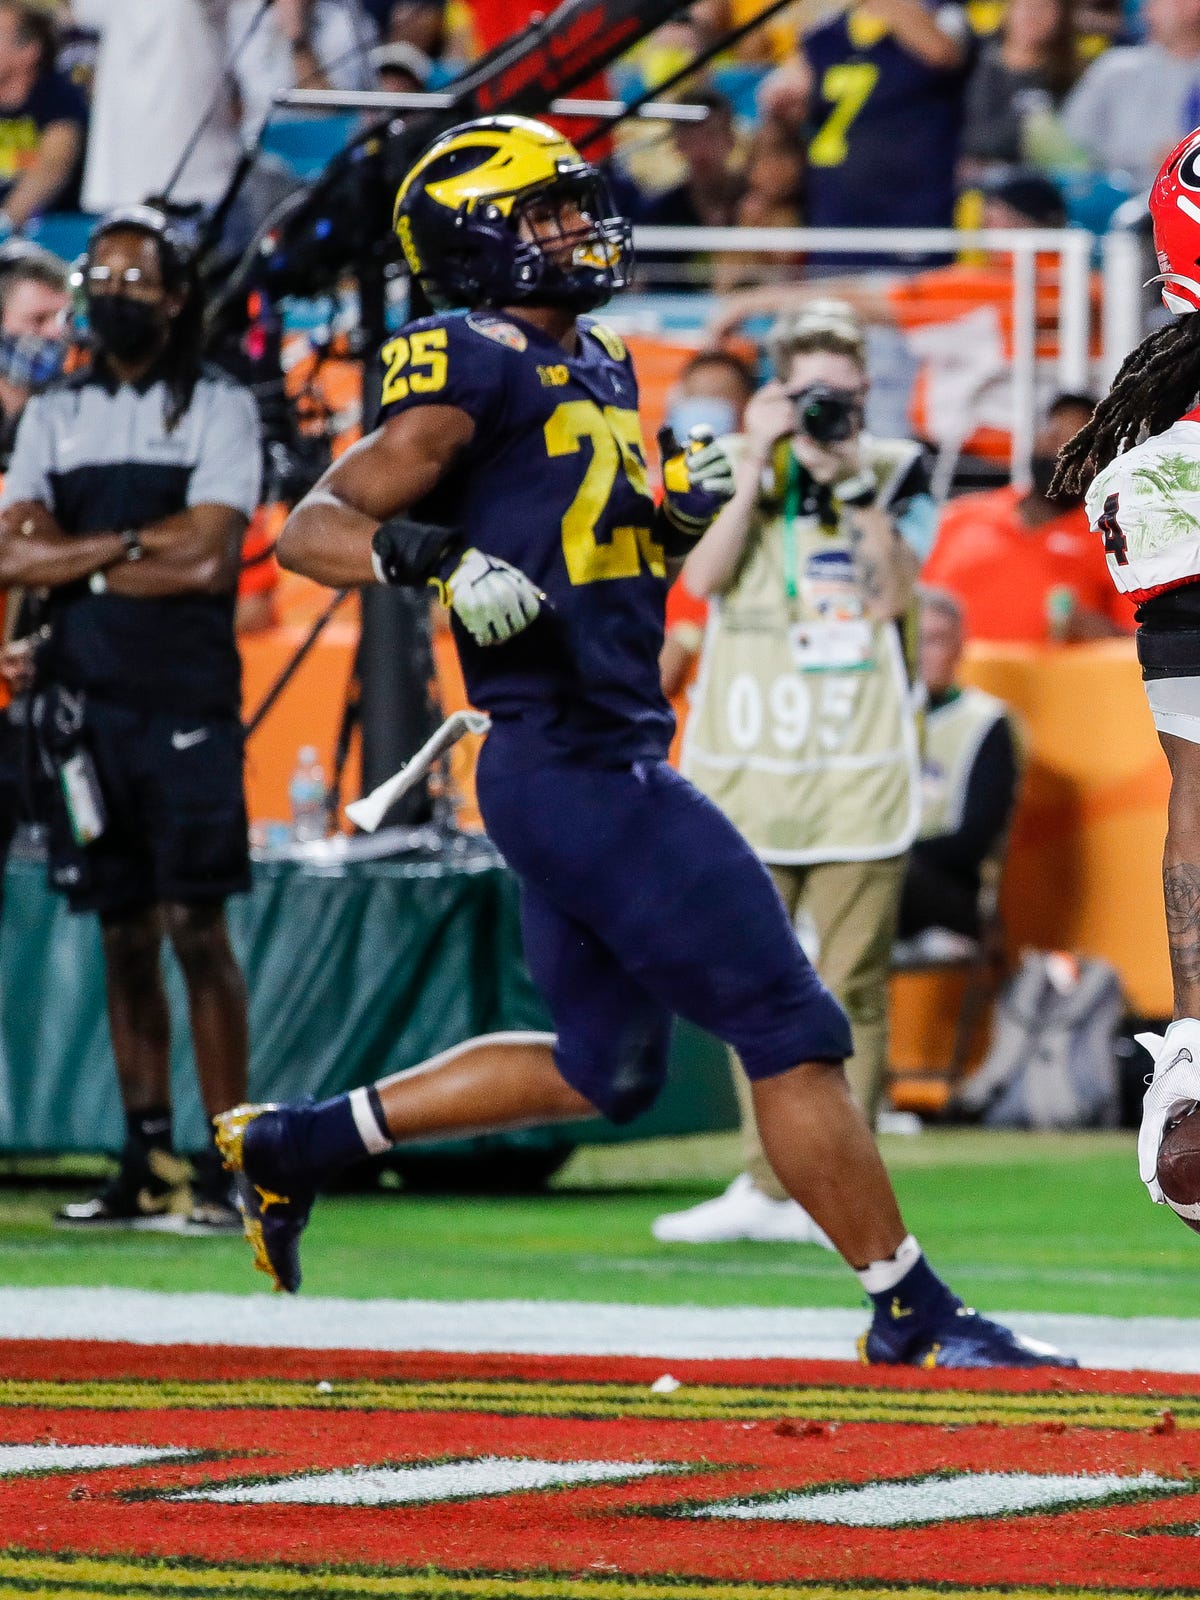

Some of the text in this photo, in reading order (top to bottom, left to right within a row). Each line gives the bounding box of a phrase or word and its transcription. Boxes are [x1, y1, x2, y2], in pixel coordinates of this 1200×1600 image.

[810, 63, 879, 167] 7
[381, 328, 448, 406] 25
[1098, 492, 1129, 567] 4
[727, 673, 858, 749] 095
